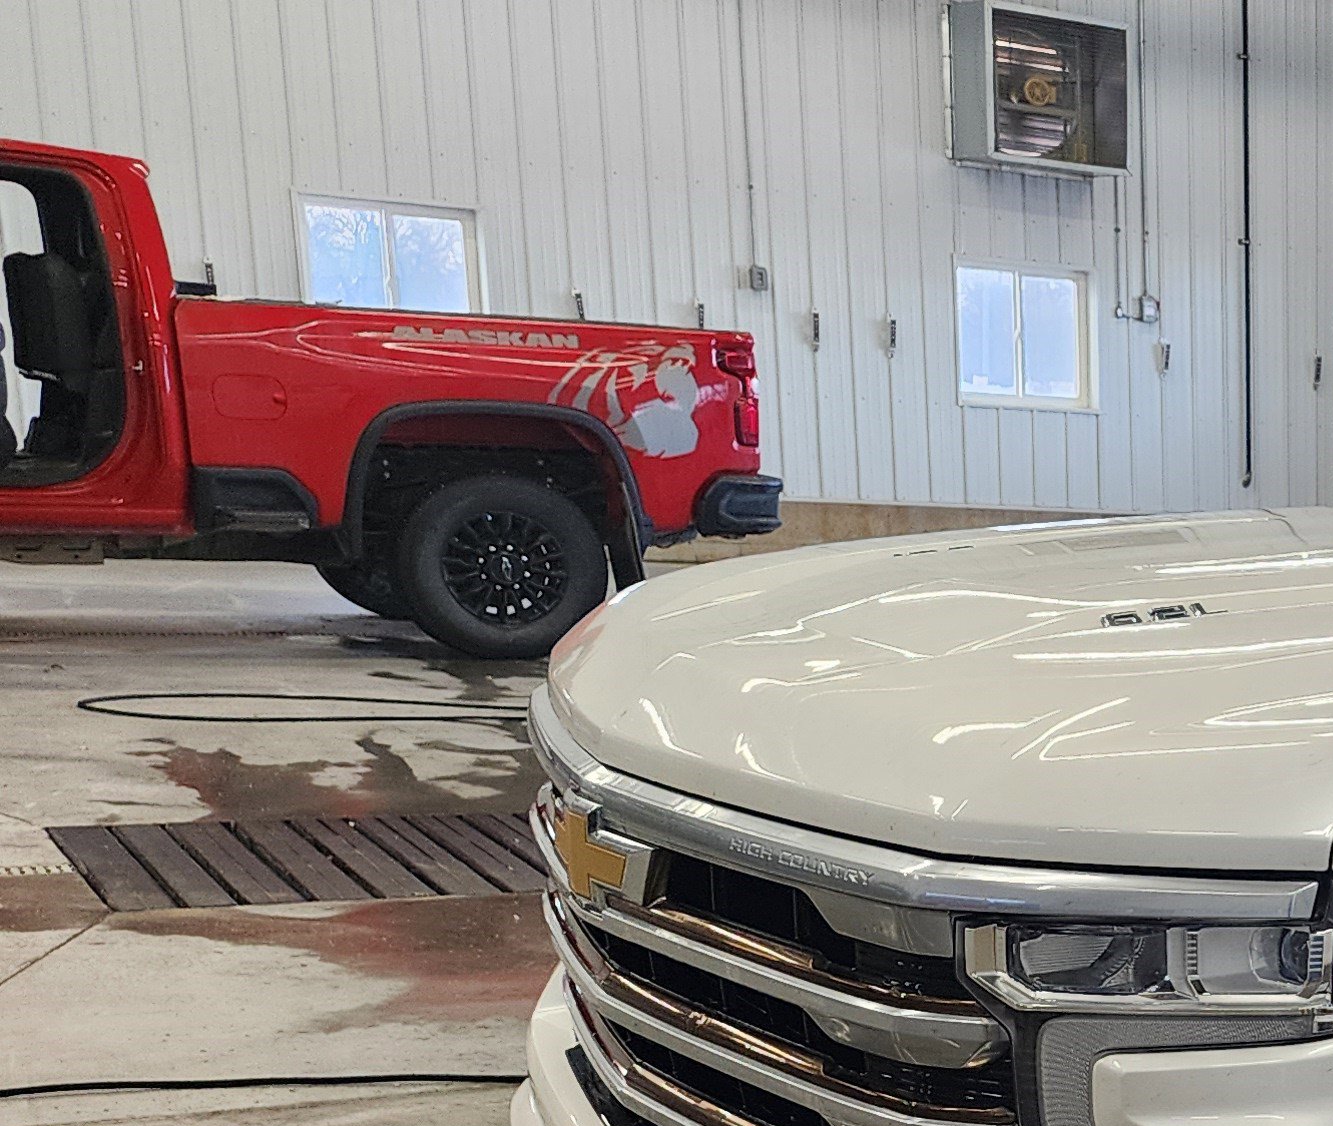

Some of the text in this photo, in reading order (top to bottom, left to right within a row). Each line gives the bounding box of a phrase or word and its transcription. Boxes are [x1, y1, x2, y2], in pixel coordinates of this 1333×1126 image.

[391, 325, 580, 348] ALASKAN
[728, 836, 875, 886] HIGH COUNTRY
